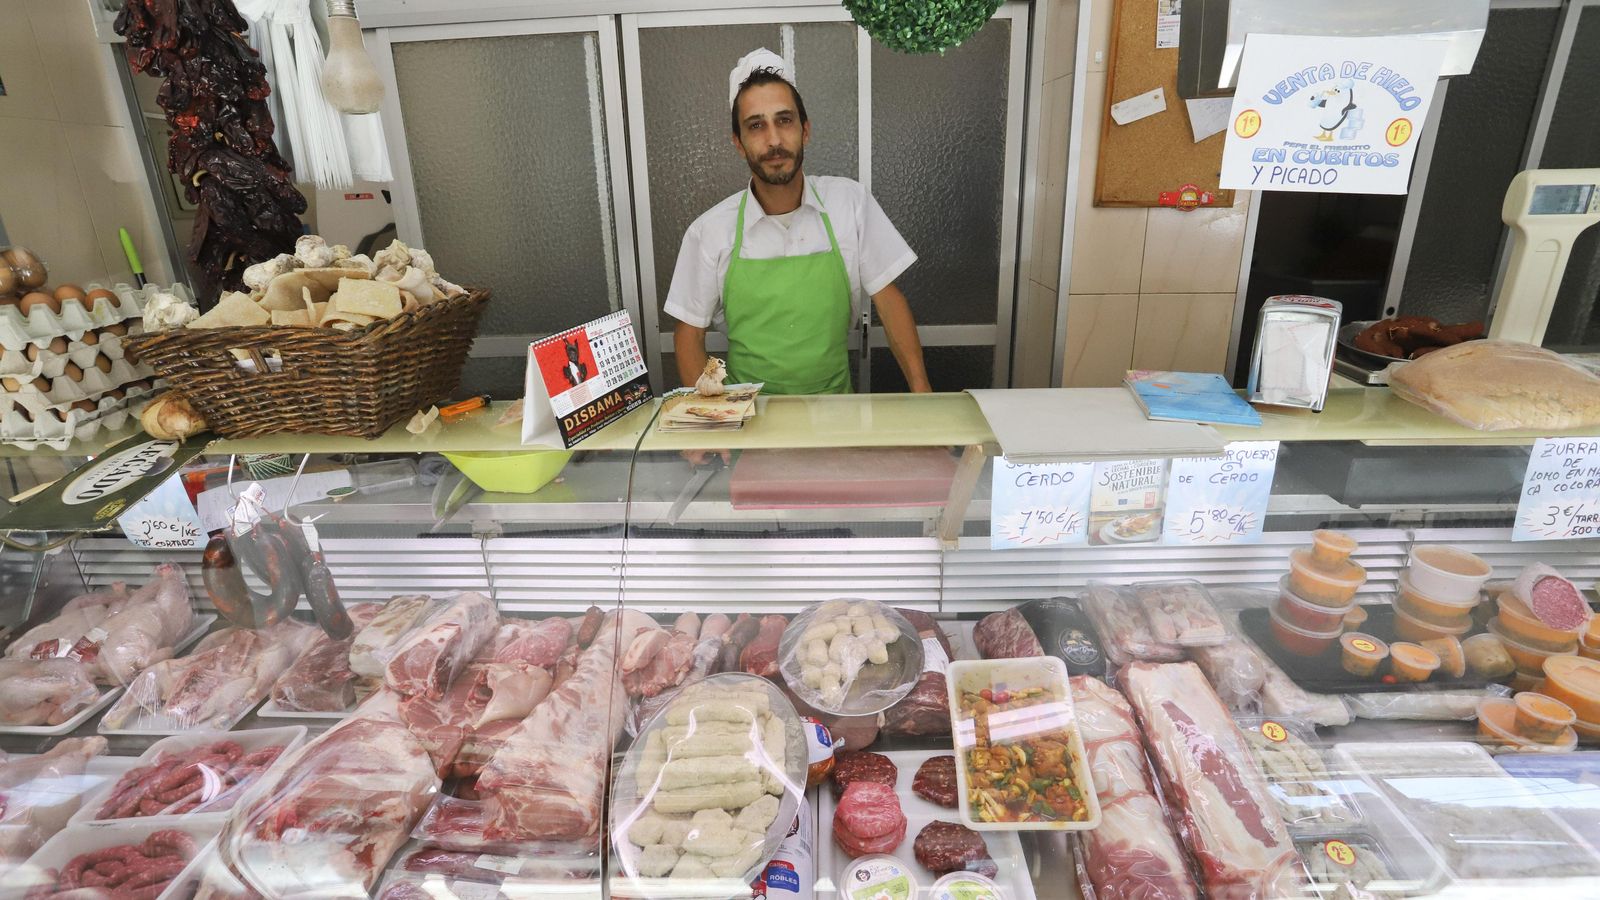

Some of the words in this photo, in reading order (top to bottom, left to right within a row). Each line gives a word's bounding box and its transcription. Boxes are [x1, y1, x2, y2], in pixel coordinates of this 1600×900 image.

[1262, 62, 1336, 105] VENTA
[1340, 60, 1373, 80] DE
[1370, 66, 1422, 111] HIELO
[1283, 141, 1308, 150] PEPE
[1252, 147, 1286, 163] EN
[1292, 149, 1400, 168] CUBITOS
[1251, 165, 1263, 185] Y
[1269, 166, 1338, 186] PICADO
[563, 391, 622, 431] DISBAMA
[1540, 442, 1598, 458] ZURRA
[76, 441, 176, 500] LEGADO
[1563, 458, 1583, 468] DE
[1015, 471, 1075, 487] CERDO
[1098, 466, 1161, 486] SOSTENIBLE
[1179, 475, 1194, 483] DE
[1209, 473, 1258, 484] CERDO
[1529, 471, 1560, 481] LOMO
[1566, 468, 1585, 479] EN
[1112, 475, 1155, 492] NATURAL
[1527, 484, 1541, 496] CA
[1571, 526, 1593, 536] 500
